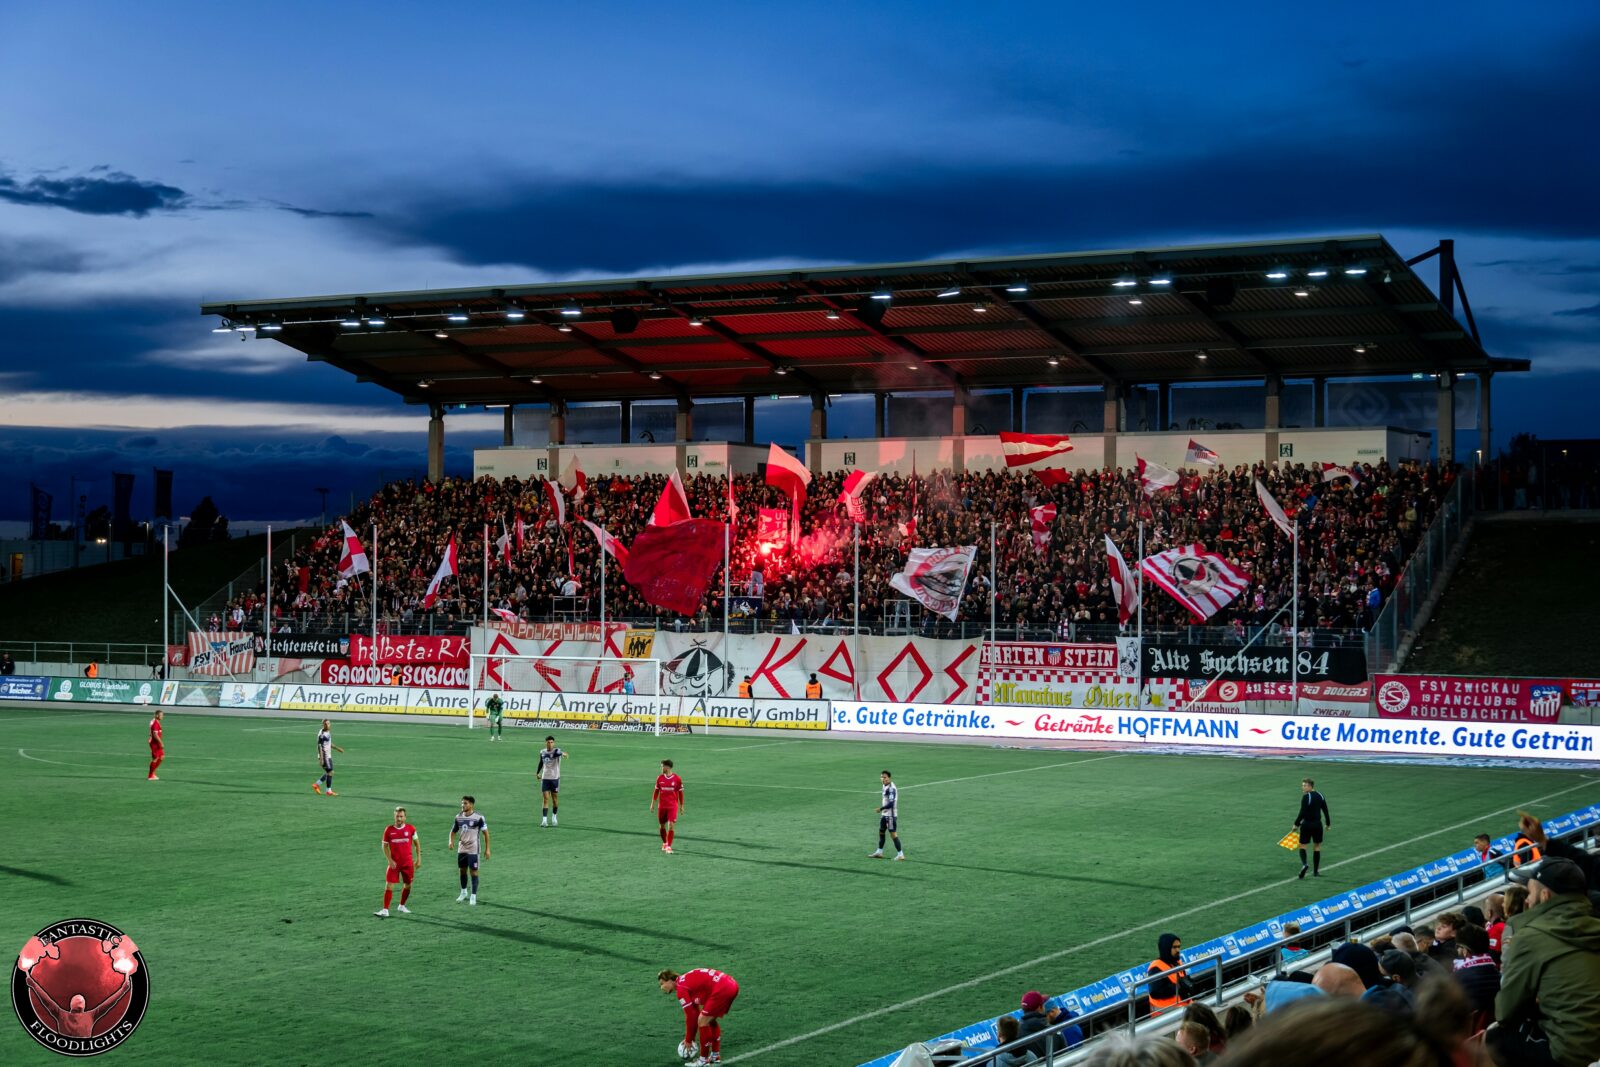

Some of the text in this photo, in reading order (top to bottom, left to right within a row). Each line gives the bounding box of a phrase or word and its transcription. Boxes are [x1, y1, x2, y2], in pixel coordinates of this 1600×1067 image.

[194, 651, 211, 666] FSV
[981, 645, 1114, 667] HARTEN STEIN
[1148, 647, 1330, 676] Alte Sachsen 84
[290, 686, 399, 707] Amrey GmbH
[1420, 680, 1520, 694] FSV ZWICKAU
[416, 689, 481, 710] Amrey
[549, 693, 618, 717] Amrey
[1433, 694, 1502, 706] FANCLUB
[690, 698, 819, 724] Amrey GmbH
[856, 706, 898, 726] Gute
[903, 708, 995, 729] Getränke.
[1411, 704, 1528, 720] RÖDELBACHTAL
[601, 722, 643, 732] Eisenbach
[1034, 714, 1239, 739] Getränke HOFFMANN
[1281, 720, 1331, 742] Gute
[1336, 722, 1446, 746] Momente.
[1452, 727, 1506, 748] Gute
